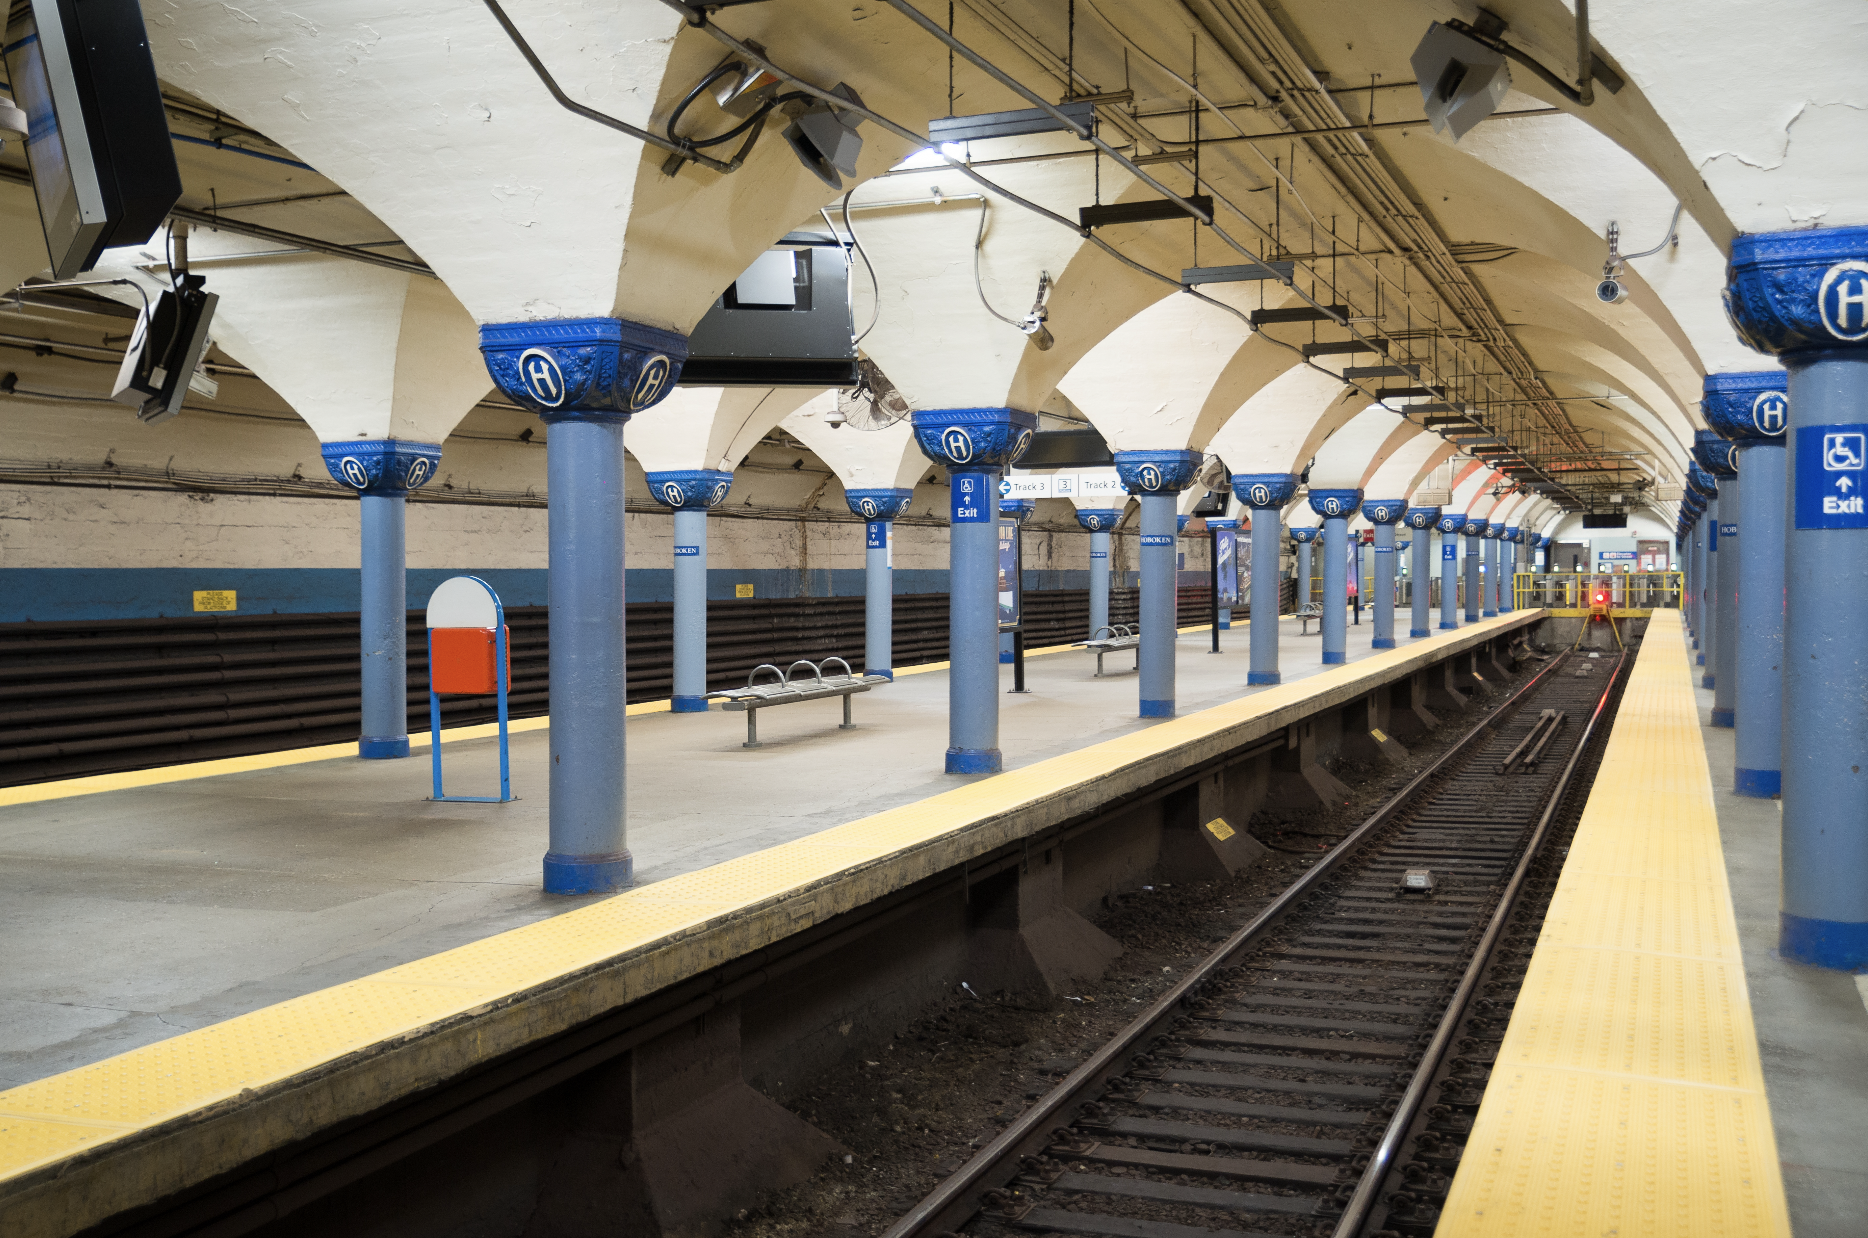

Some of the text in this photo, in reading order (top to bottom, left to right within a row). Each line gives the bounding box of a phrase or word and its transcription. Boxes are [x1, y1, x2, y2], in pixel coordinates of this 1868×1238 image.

[1014, 482, 1045, 491] Track 3
[1062, 480, 1067, 488] 3
[1085, 481, 1108, 489] Track
[1823, 497, 1864, 514] Exit
[958, 507, 977, 517] Exit
